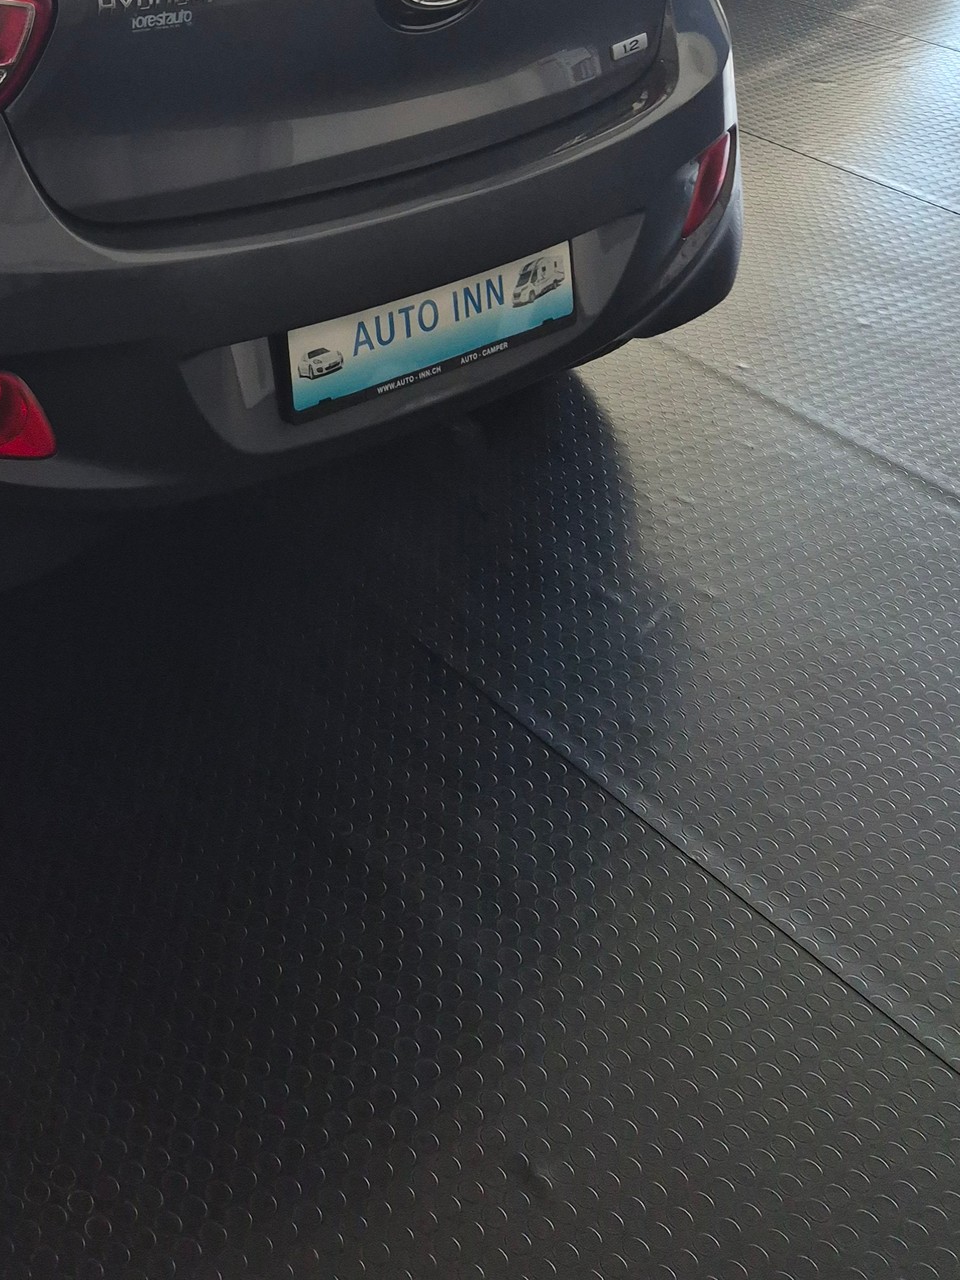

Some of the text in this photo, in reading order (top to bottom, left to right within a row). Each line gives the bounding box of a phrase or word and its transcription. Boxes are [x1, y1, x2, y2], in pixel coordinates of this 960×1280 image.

[352, 274, 506, 357] AUTO INN
[460, 352, 478, 365] AUTO
[482, 341, 509, 357] CAMPER
